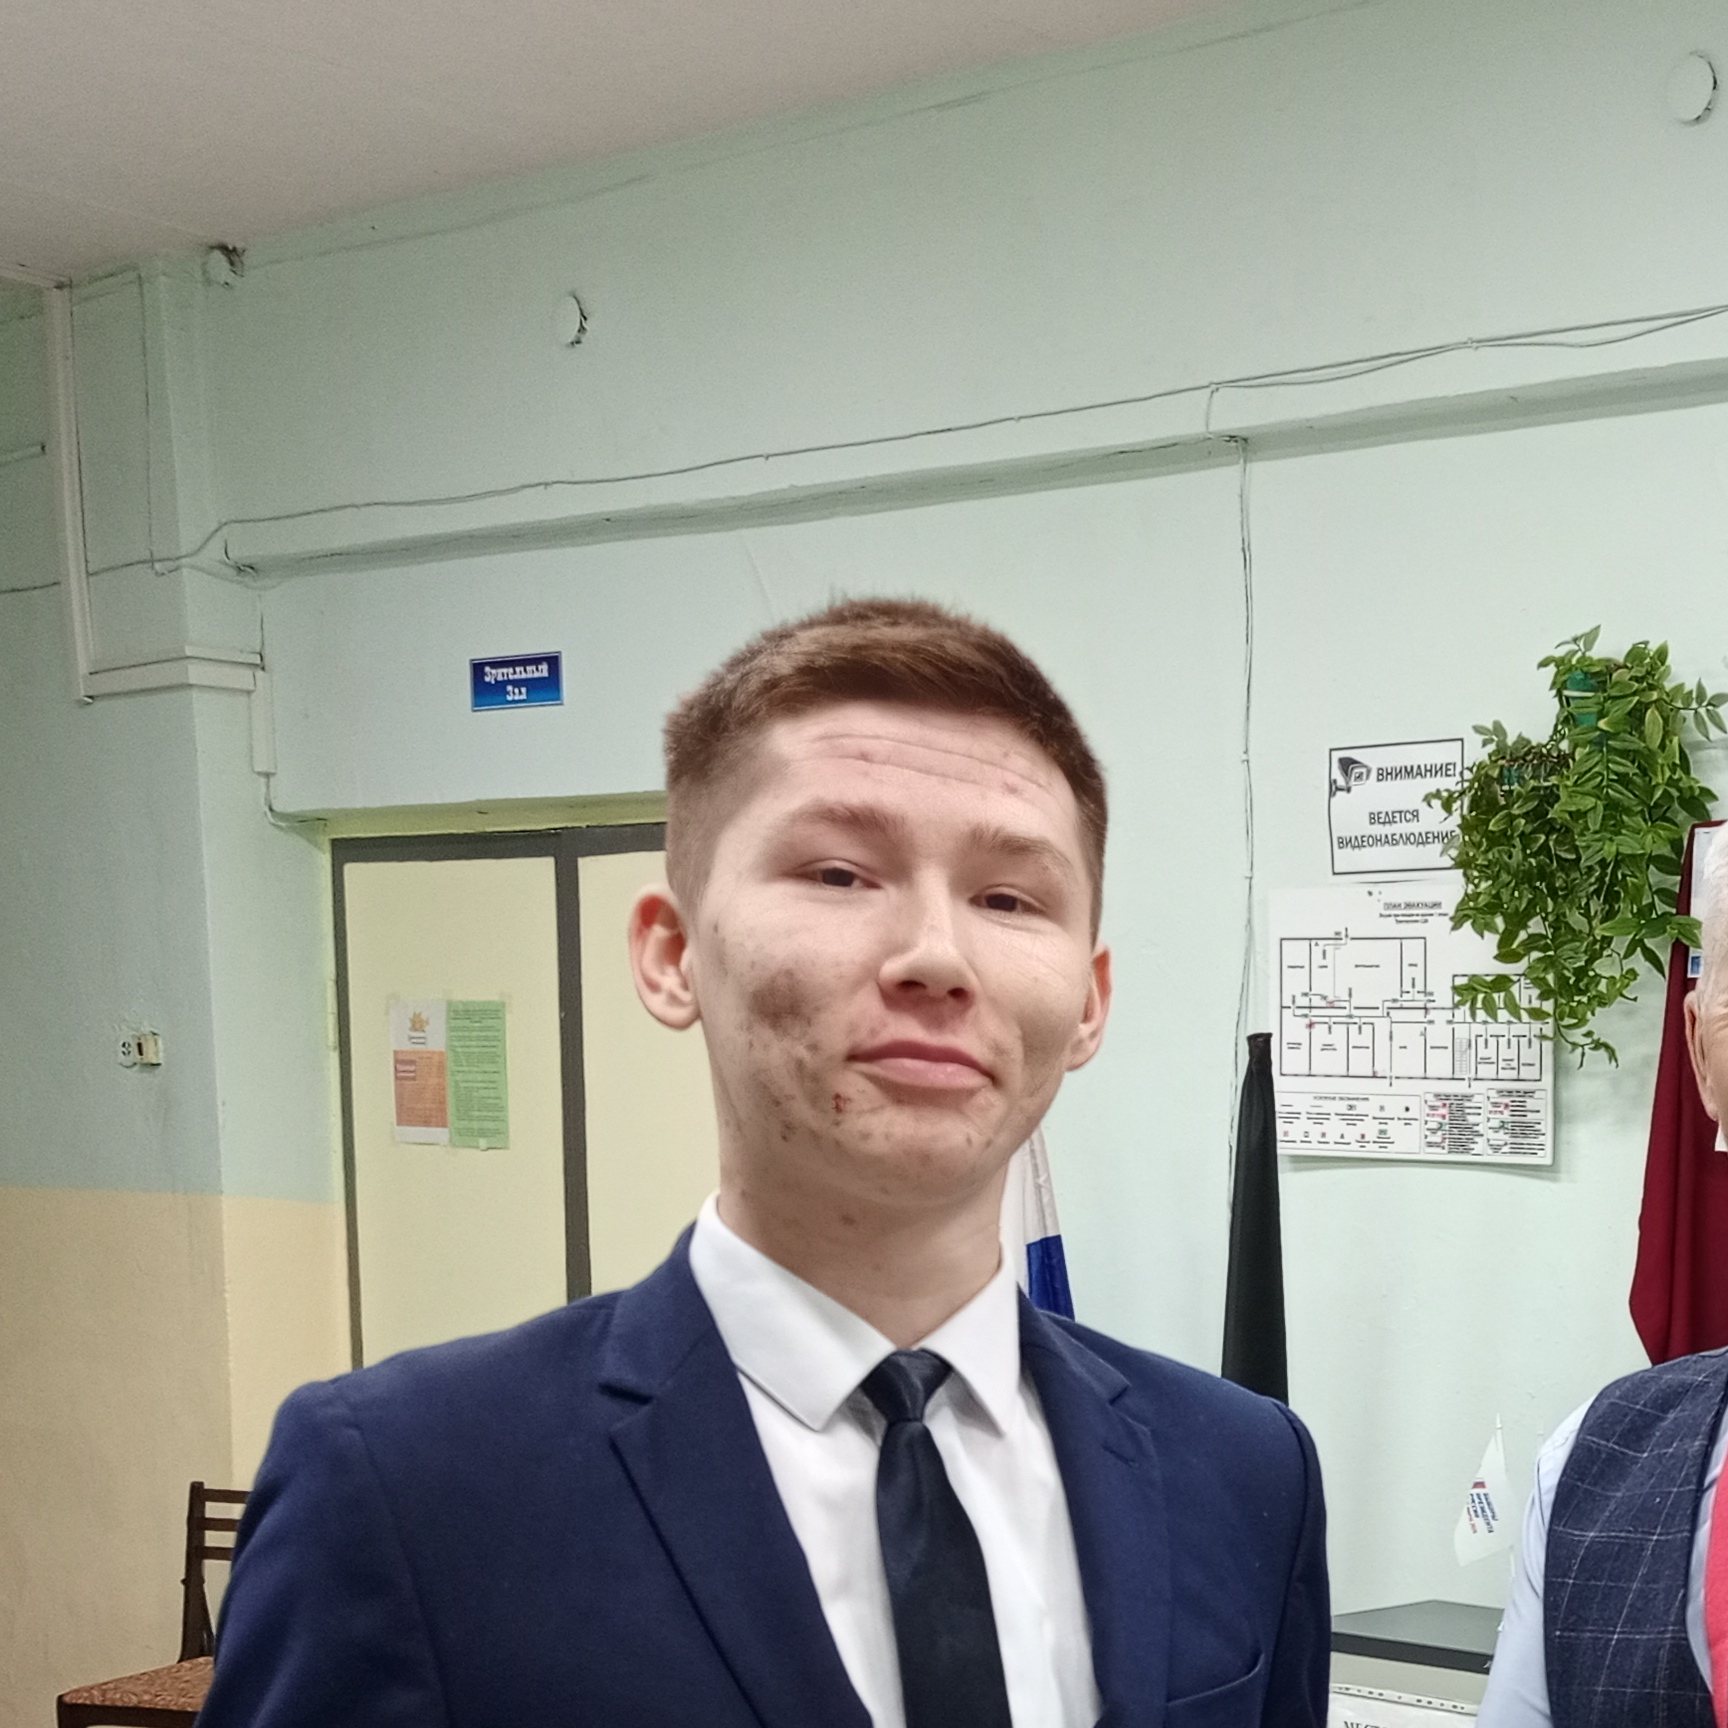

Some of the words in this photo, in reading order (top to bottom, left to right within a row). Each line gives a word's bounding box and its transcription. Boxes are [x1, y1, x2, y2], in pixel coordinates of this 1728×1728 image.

[484, 662, 549, 684] Зрительный
[506, 685, 527, 700] Зал
[1376, 762, 1457, 782] ВНИМАНИЕ!
[1368, 809, 1420, 827] ВЕДЕТСЯ
